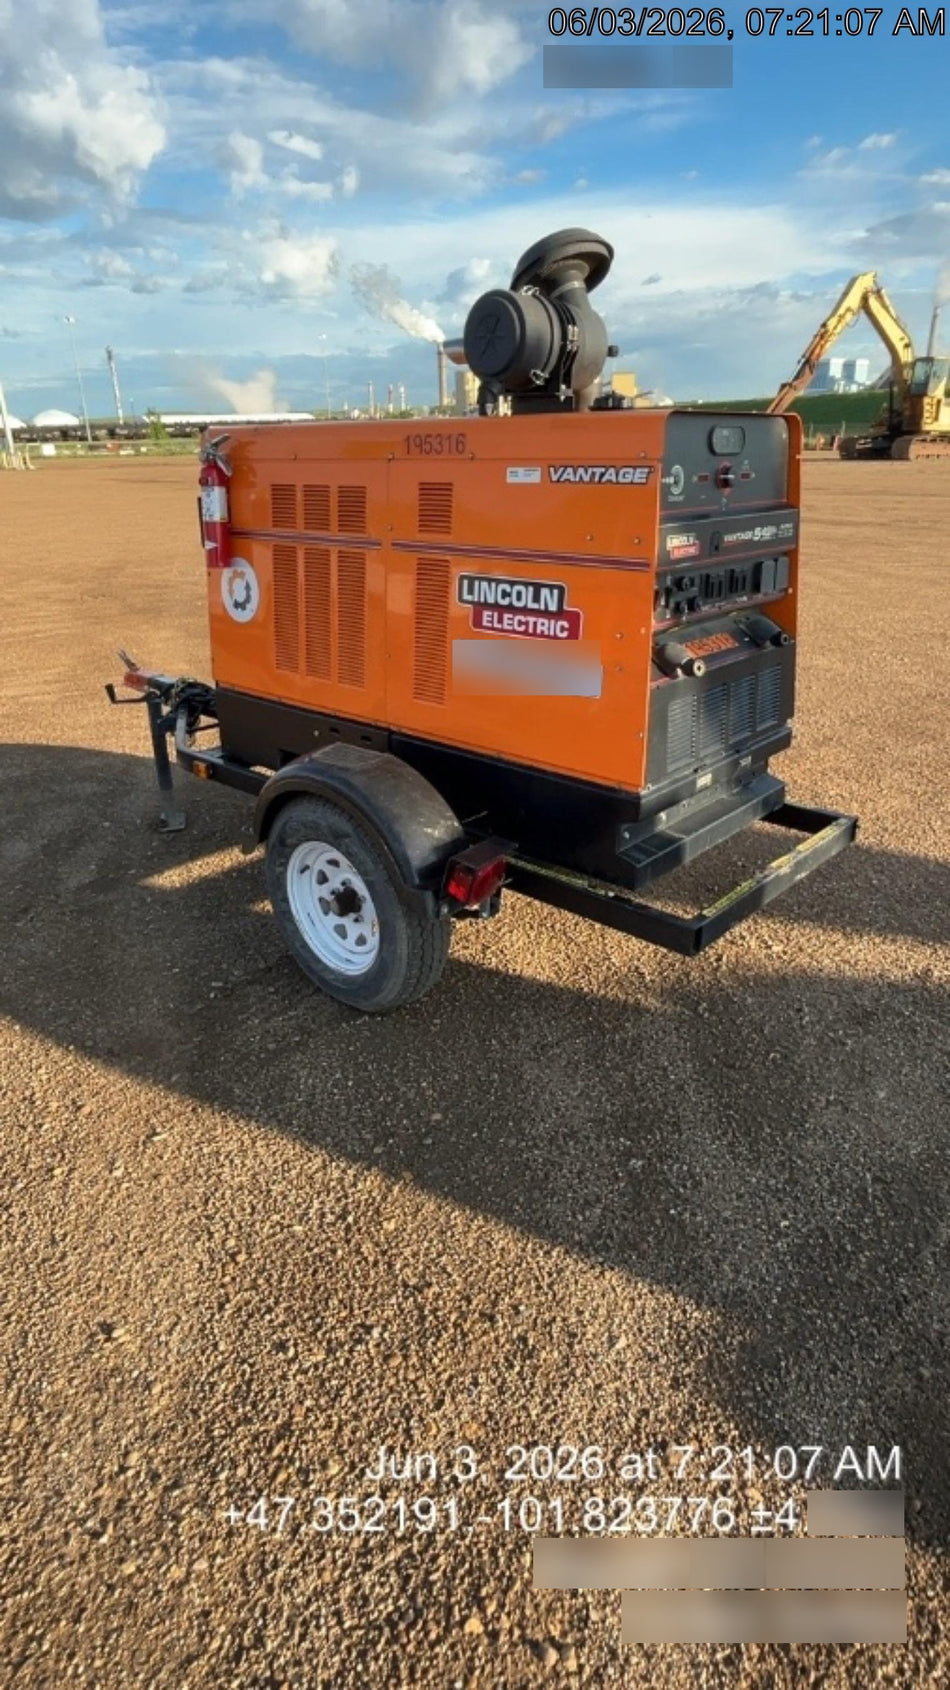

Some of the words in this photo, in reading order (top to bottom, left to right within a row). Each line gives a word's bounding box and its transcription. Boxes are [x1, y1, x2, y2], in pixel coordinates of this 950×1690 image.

[404, 433, 467, 455] 195316
[549, 466, 650, 484] VANTAGE
[462, 580, 559, 612] LINCOLN
[482, 610, 570, 638] ELECTRIC
